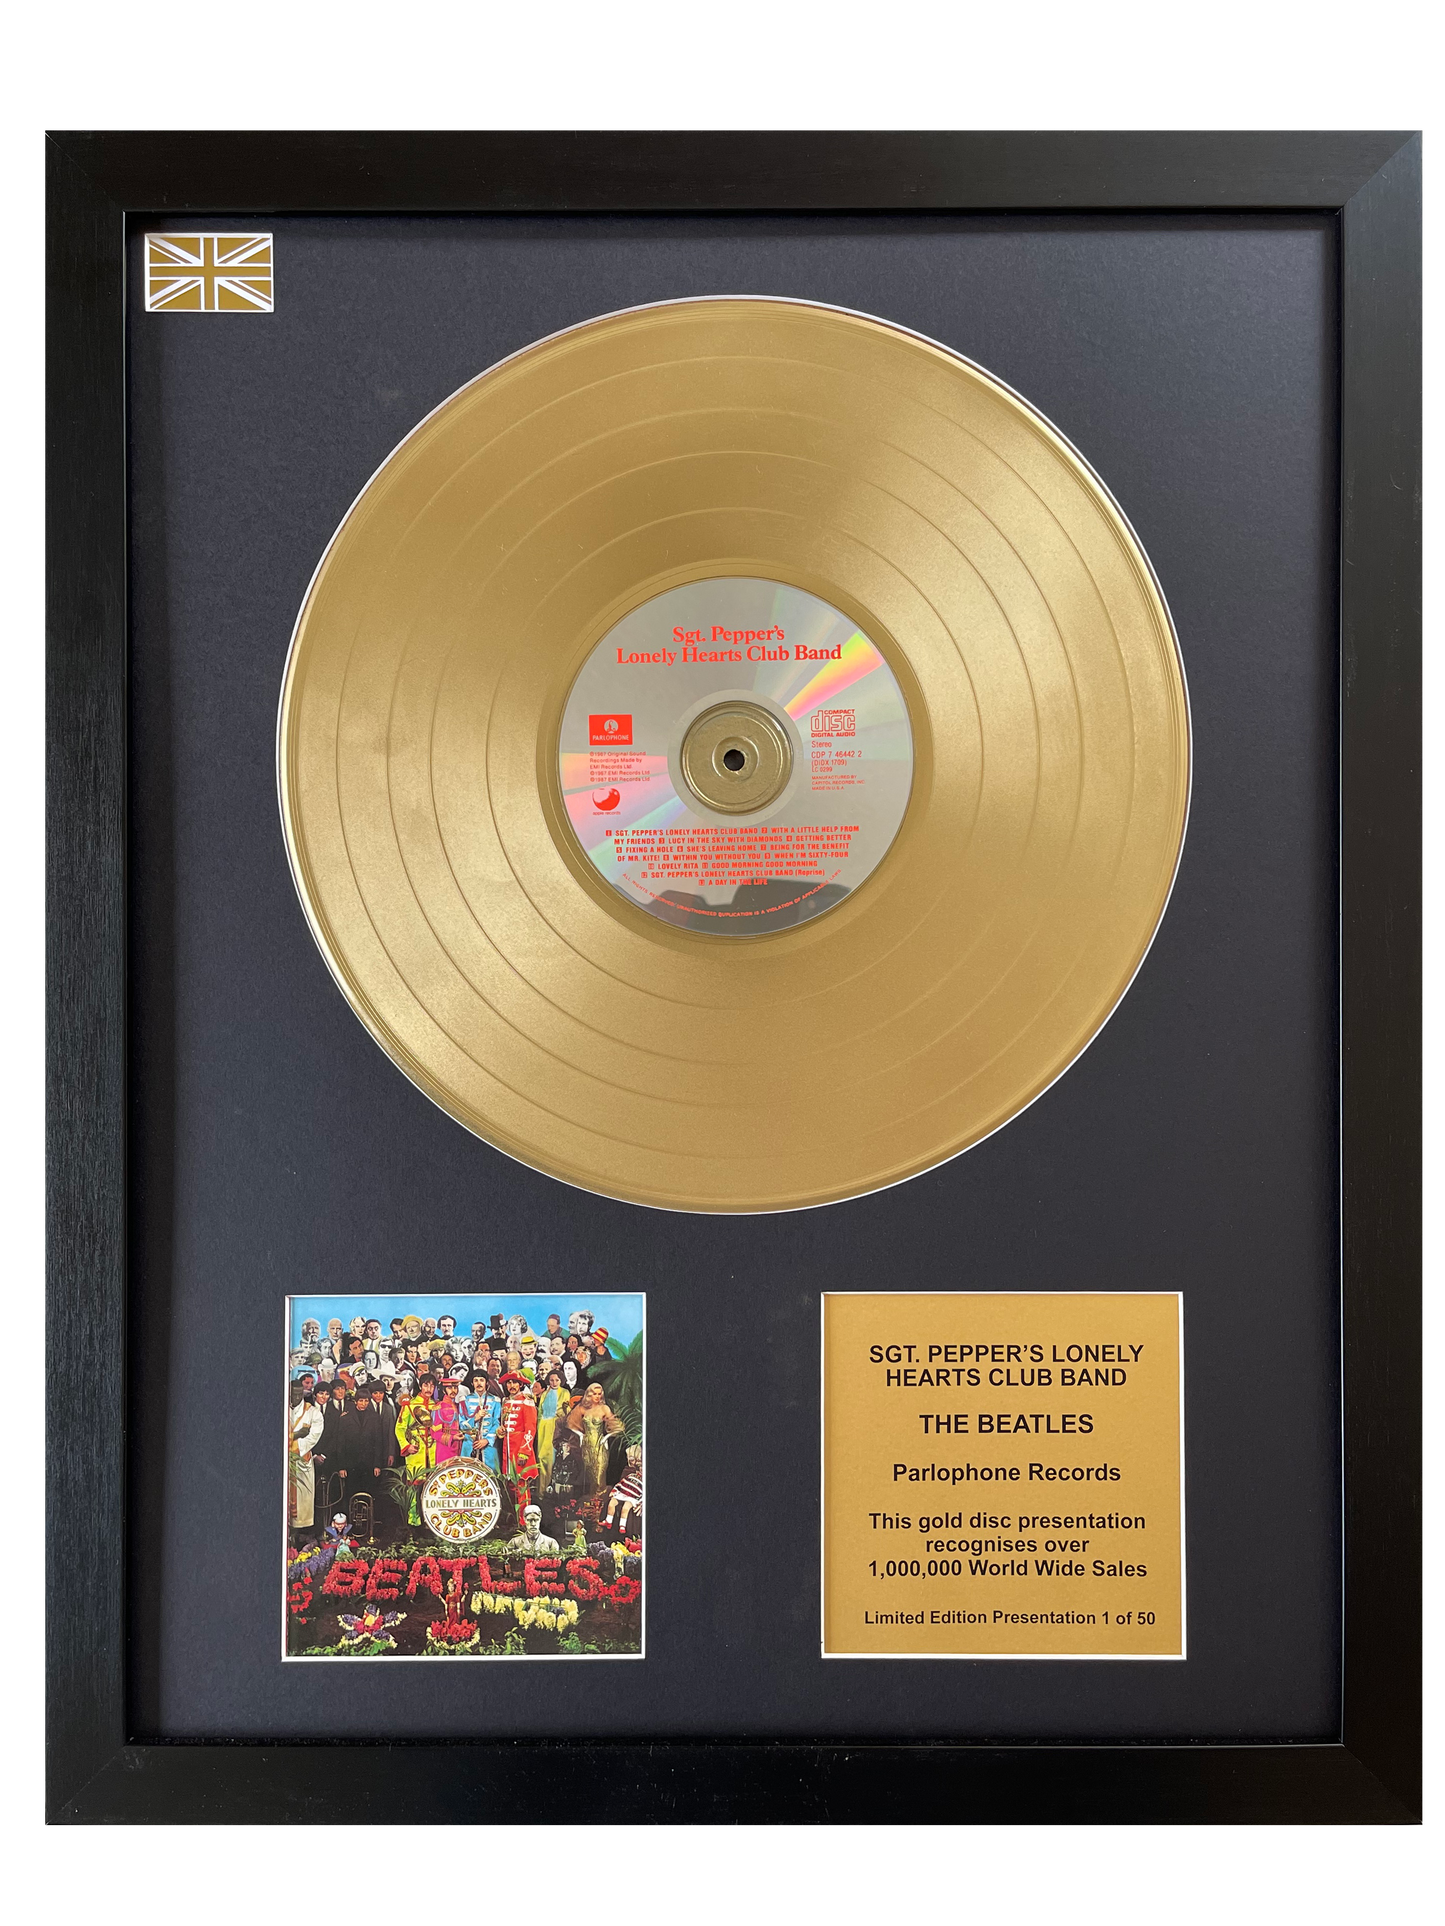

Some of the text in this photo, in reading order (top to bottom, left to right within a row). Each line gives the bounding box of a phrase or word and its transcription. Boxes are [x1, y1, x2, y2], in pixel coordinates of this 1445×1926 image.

[672, 626, 706, 647] Sgt.
[616, 644, 842, 665] Lonely Hearts Club Band
[811, 710, 855, 732] disc
[825, 833, 851, 841] BETTER
[869, 1344, 919, 1363] SGT.
[1052, 1344, 1144, 1362] LONELY
[886, 1368, 1126, 1386] HEARTS CLUB BAND
[918, 1414, 1093, 1433] THE BEATLES
[439, 1469, 493, 1496] PEPPERS
[893, 1463, 1121, 1485] Parlophone Records
[426, 1499, 497, 1508] LONELY HEARTS
[431, 1512, 492, 1538] CLUB BAND
[868, 1512, 1145, 1532] This gold disc presentation
[926, 1536, 1089, 1556] recognises over
[323, 1556, 603, 1601] BEATLES
[868, 1559, 1147, 1578] 1,000,000 World Wide Sales
[864, 1610, 1155, 1625] Limited Edition Presentation 1 of 50
